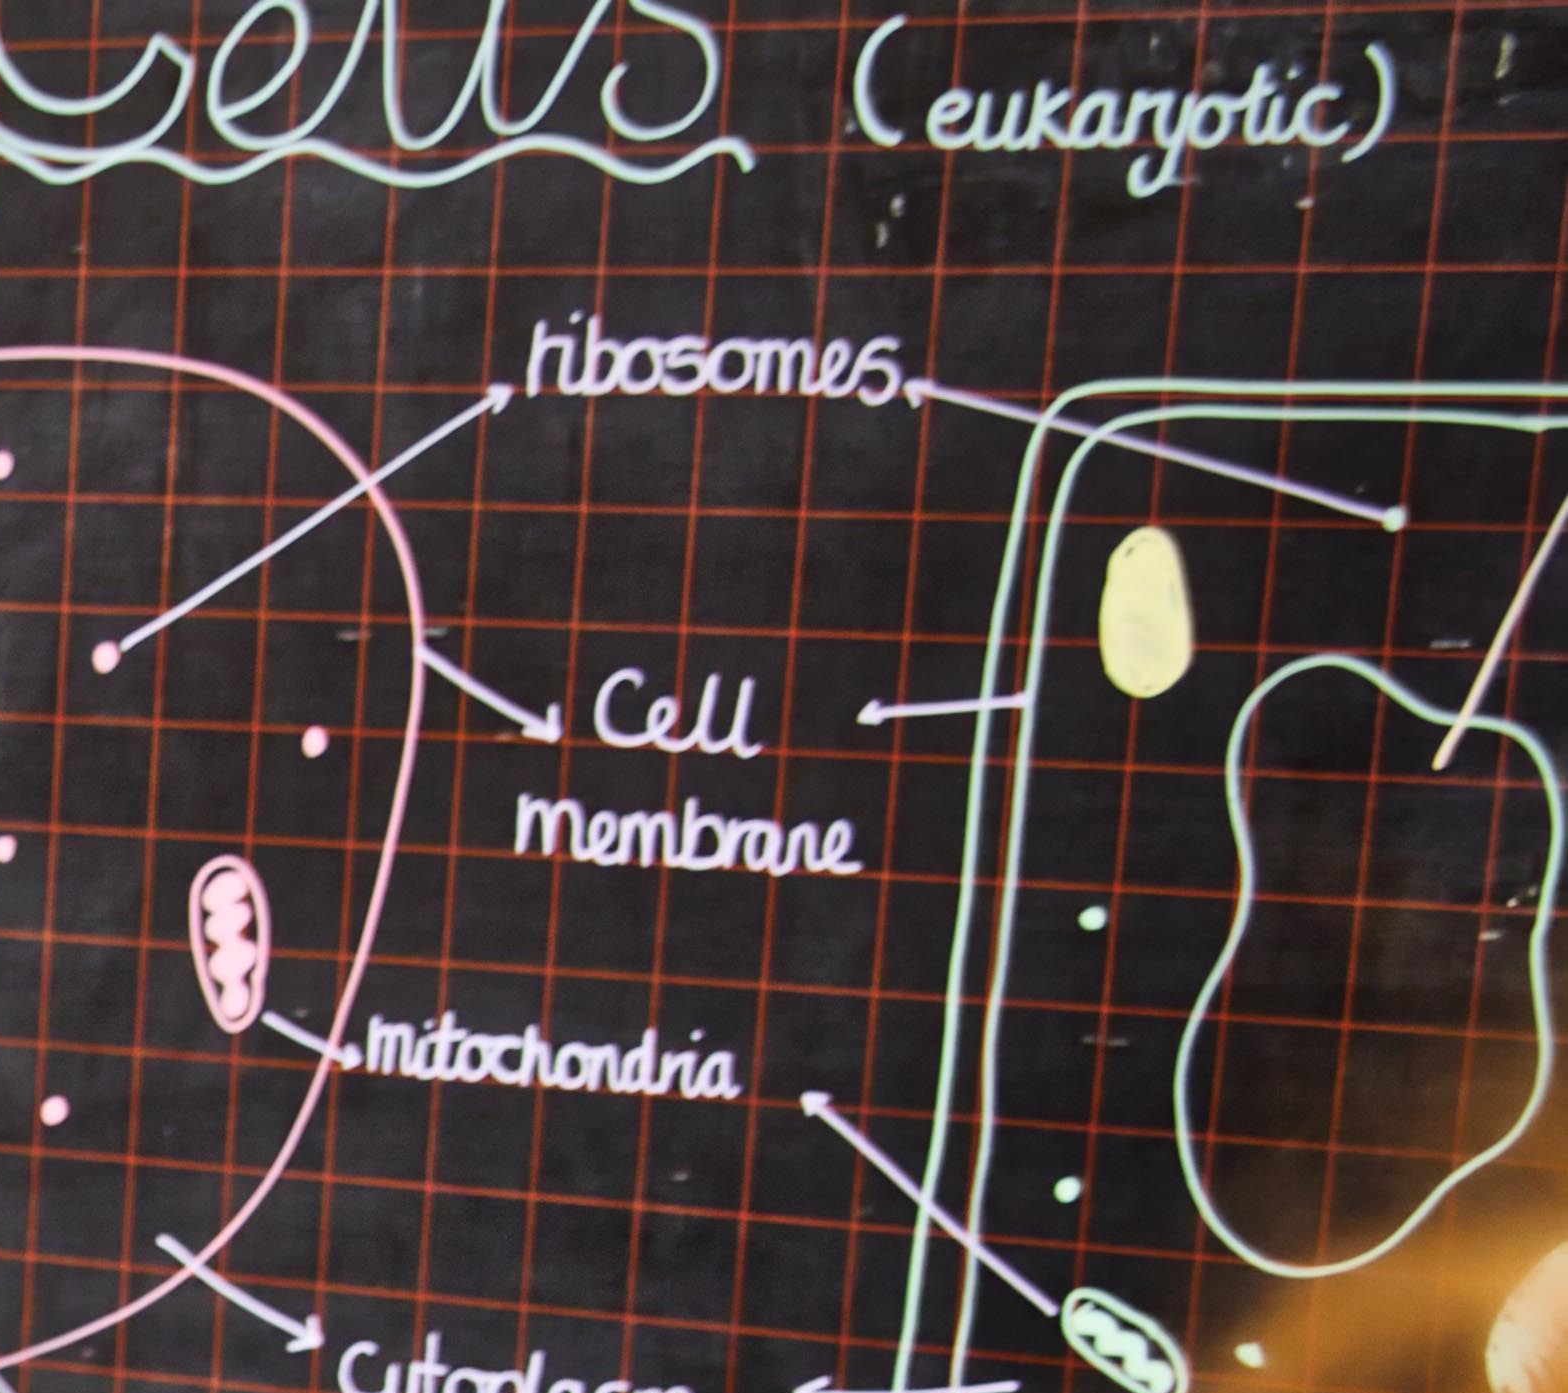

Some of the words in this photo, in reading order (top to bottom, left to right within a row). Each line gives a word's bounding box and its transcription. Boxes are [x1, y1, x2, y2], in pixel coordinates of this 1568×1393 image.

[524, 309, 906, 403] ribosomes
[593, 668, 762, 758] Cell
[513, 783, 865, 876] membrane
[364, 1012, 741, 1102] mitochondria
